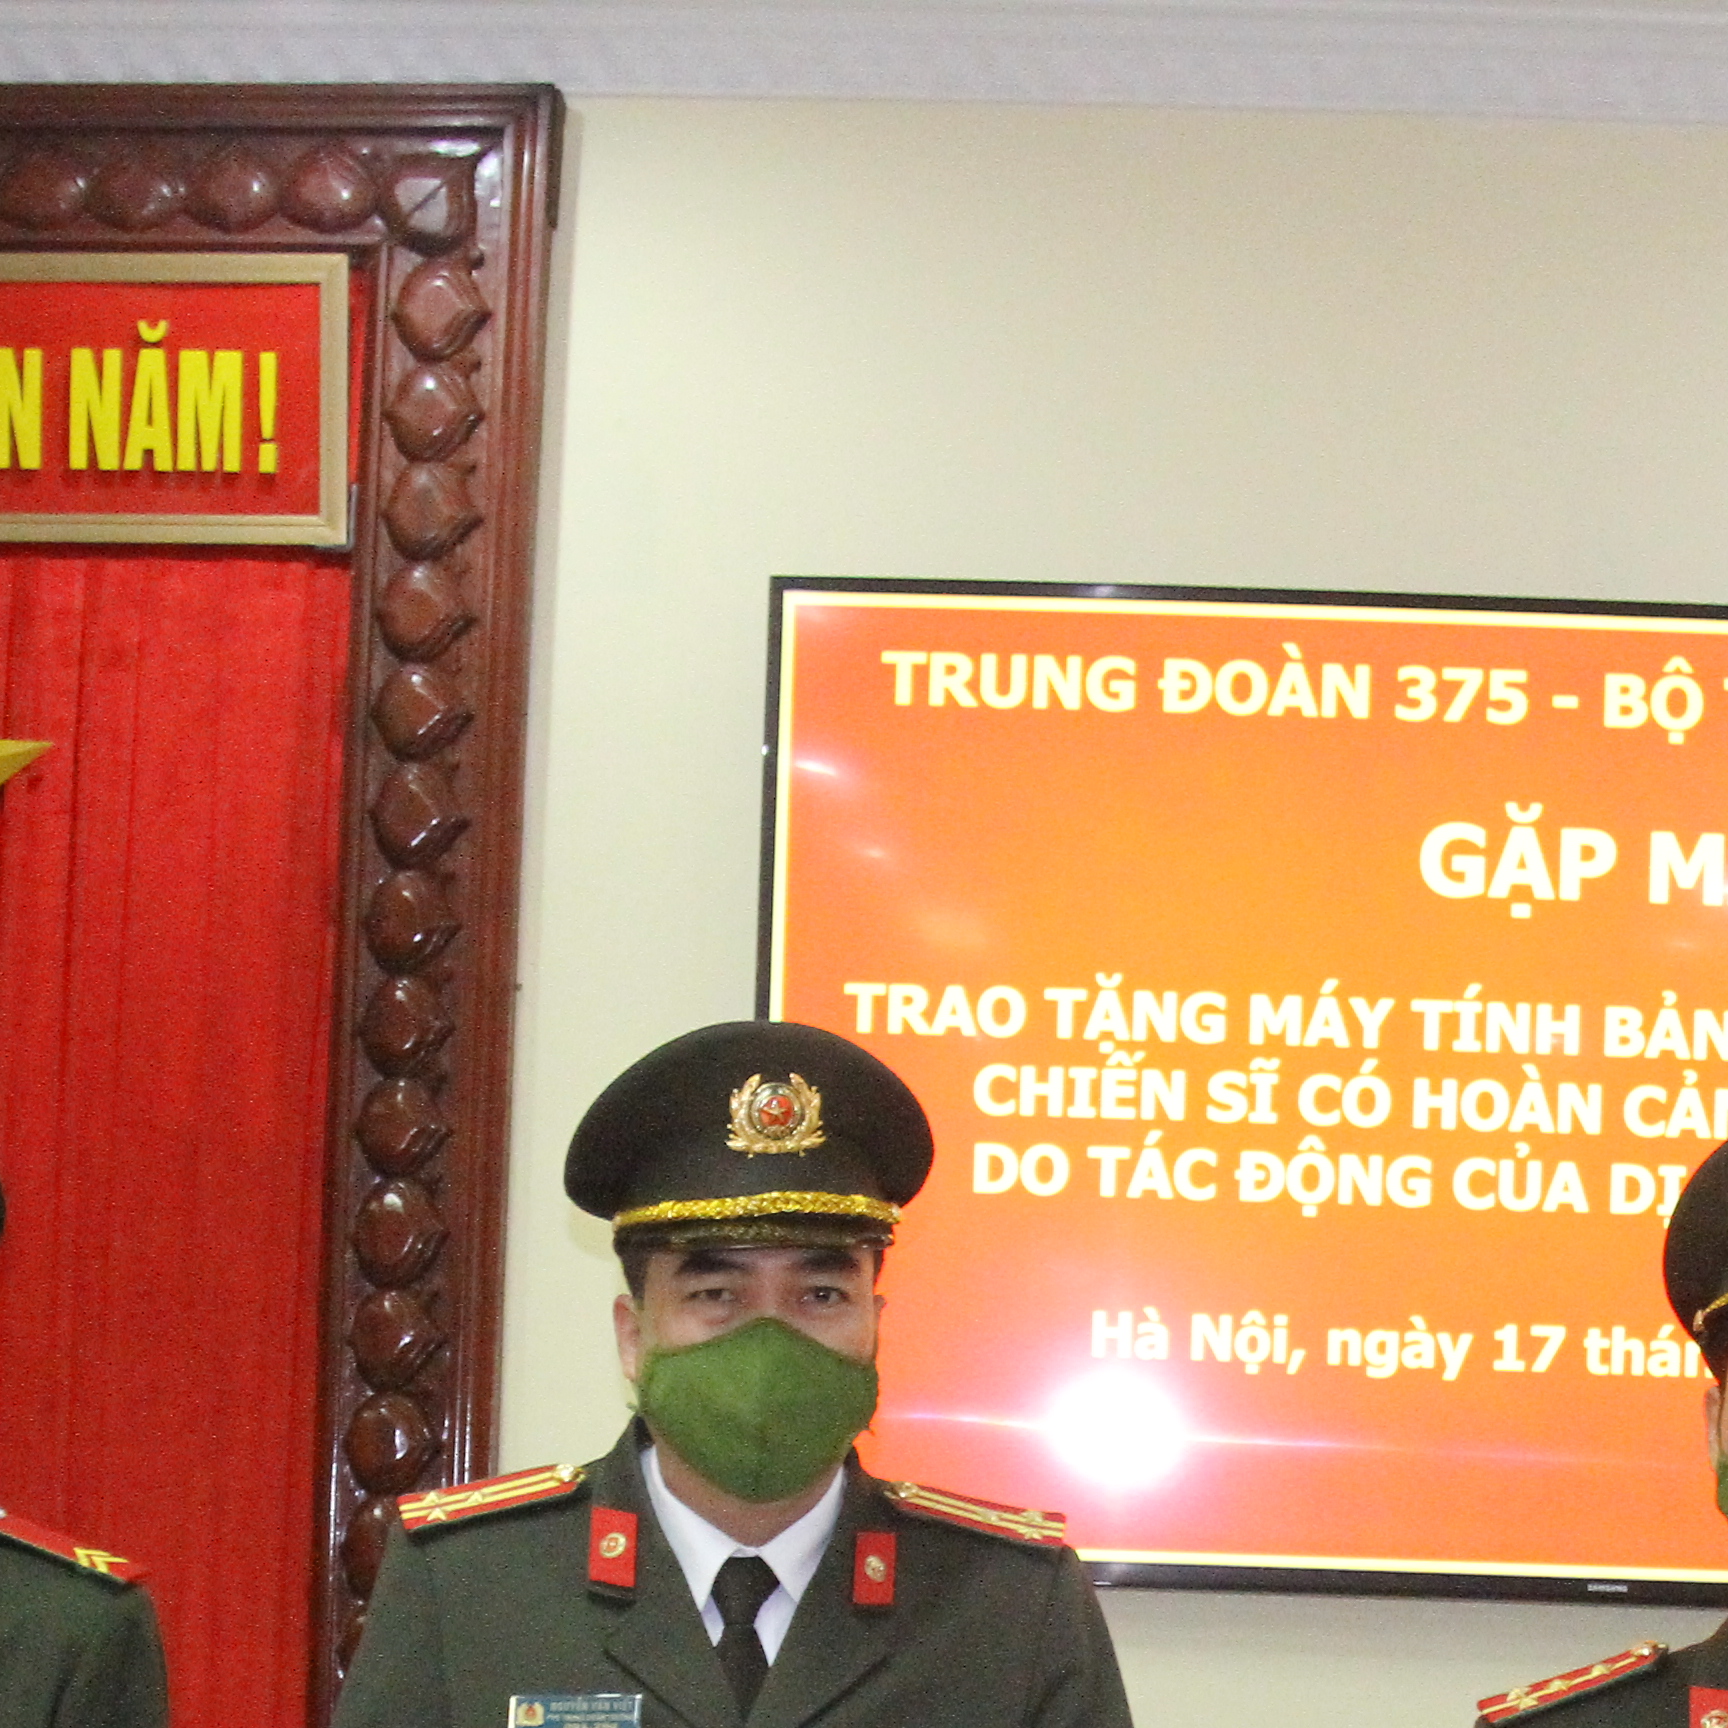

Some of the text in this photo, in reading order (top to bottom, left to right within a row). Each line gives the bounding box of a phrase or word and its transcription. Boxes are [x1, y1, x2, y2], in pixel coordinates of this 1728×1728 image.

[881, 650, 1137, 712] TRUNG
[1159, 643, 1371, 719] ĐOÀN
[1395, 665, 1530, 726] 375
[1552, 693, 1579, 709] -
[1603, 656, 1706, 746] BỘ
[1419, 802, 1619, 920] GẶP
[844, 982, 1026, 1041] TRAO
[1044, 972, 1228, 1055] TẶNG
[1248, 979, 1394, 1050] MÁY
[1411, 983, 1582, 1057] TÍNH
[972, 1050, 1187, 1121] CHIẾN
[1205, 1056, 1282, 1125] SĨ
[1297, 1058, 1392, 1128] CÓ
[1411, 1066, 1603, 1136] HOÀN
[972, 1142, 1070, 1198] DO
[1087, 1130, 1218, 1203] TÁC
[1234, 1134, 1434, 1218] ĐỘNG
[1452, 1142, 1590, 1216] CỦA
[1091, 1308, 1171, 1361] Hà
[1190, 1313, 1308, 1377] Nội,
[1326, 1315, 1474, 1382] ngày
[1491, 1324, 1566, 1374] 17
